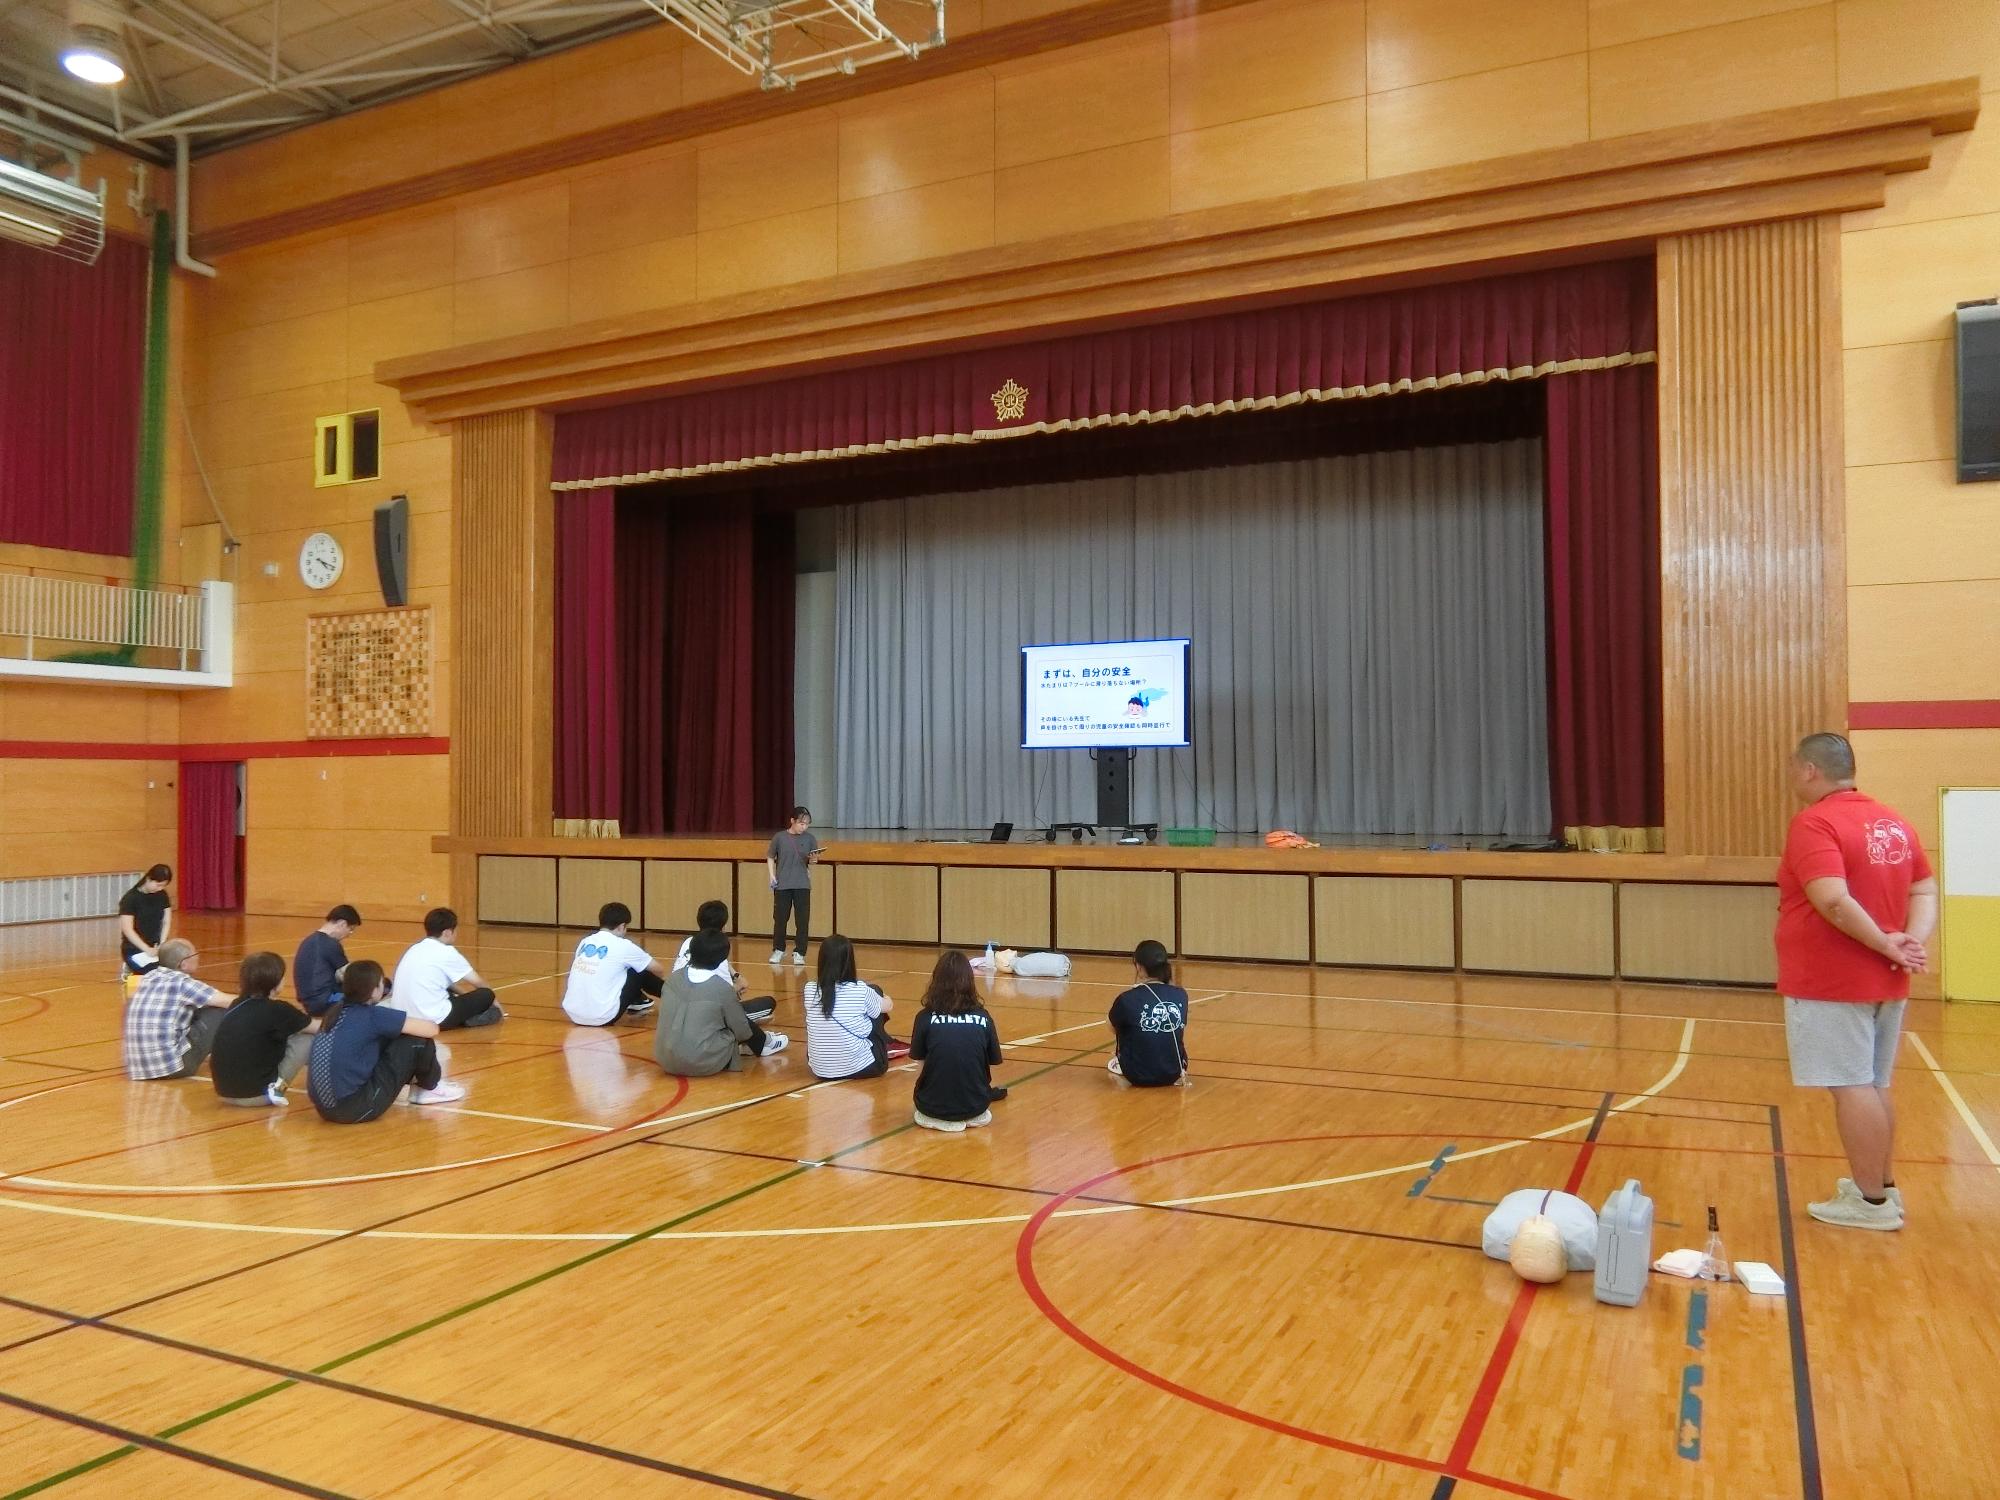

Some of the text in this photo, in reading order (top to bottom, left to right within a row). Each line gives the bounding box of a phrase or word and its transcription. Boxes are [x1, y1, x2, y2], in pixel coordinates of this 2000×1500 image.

[1043, 666, 1131, 679] まずは、自分の安全
[931, 1014, 986, 1027] ATHLETA
